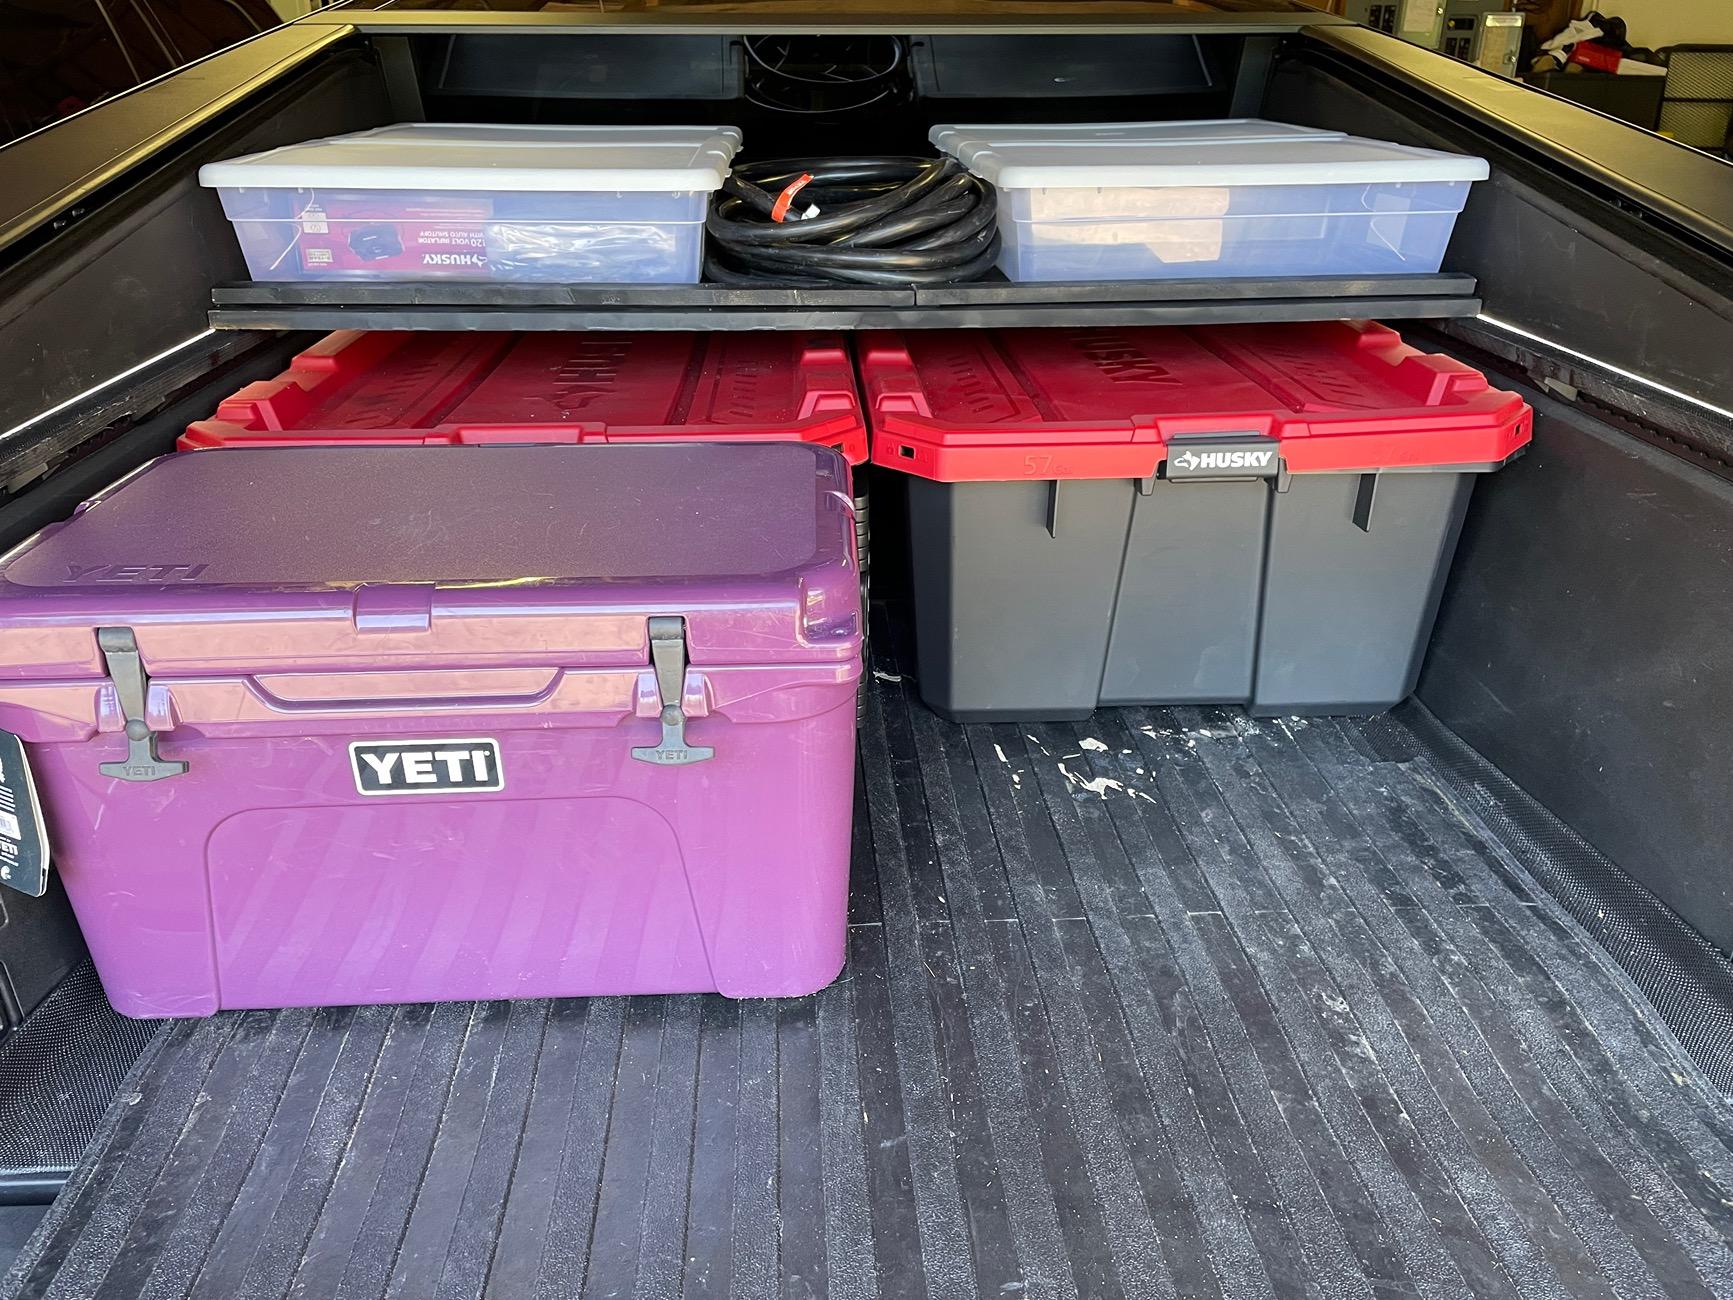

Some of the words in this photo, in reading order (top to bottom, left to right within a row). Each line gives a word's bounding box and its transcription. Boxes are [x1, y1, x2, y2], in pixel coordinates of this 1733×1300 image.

[419, 230, 449, 238] SHUTOFF
[452, 238, 470, 246] VOLT
[470, 238, 486, 248] 120
[423, 253, 471, 265] HUSKY
[1023, 455, 1053, 476] 57
[1200, 451, 1272, 468] HUSKY
[63, 563, 210, 583] YETI
[655, 749, 688, 760] YETI
[122, 765, 156, 777] YETI
[360, 750, 490, 785] YETI
